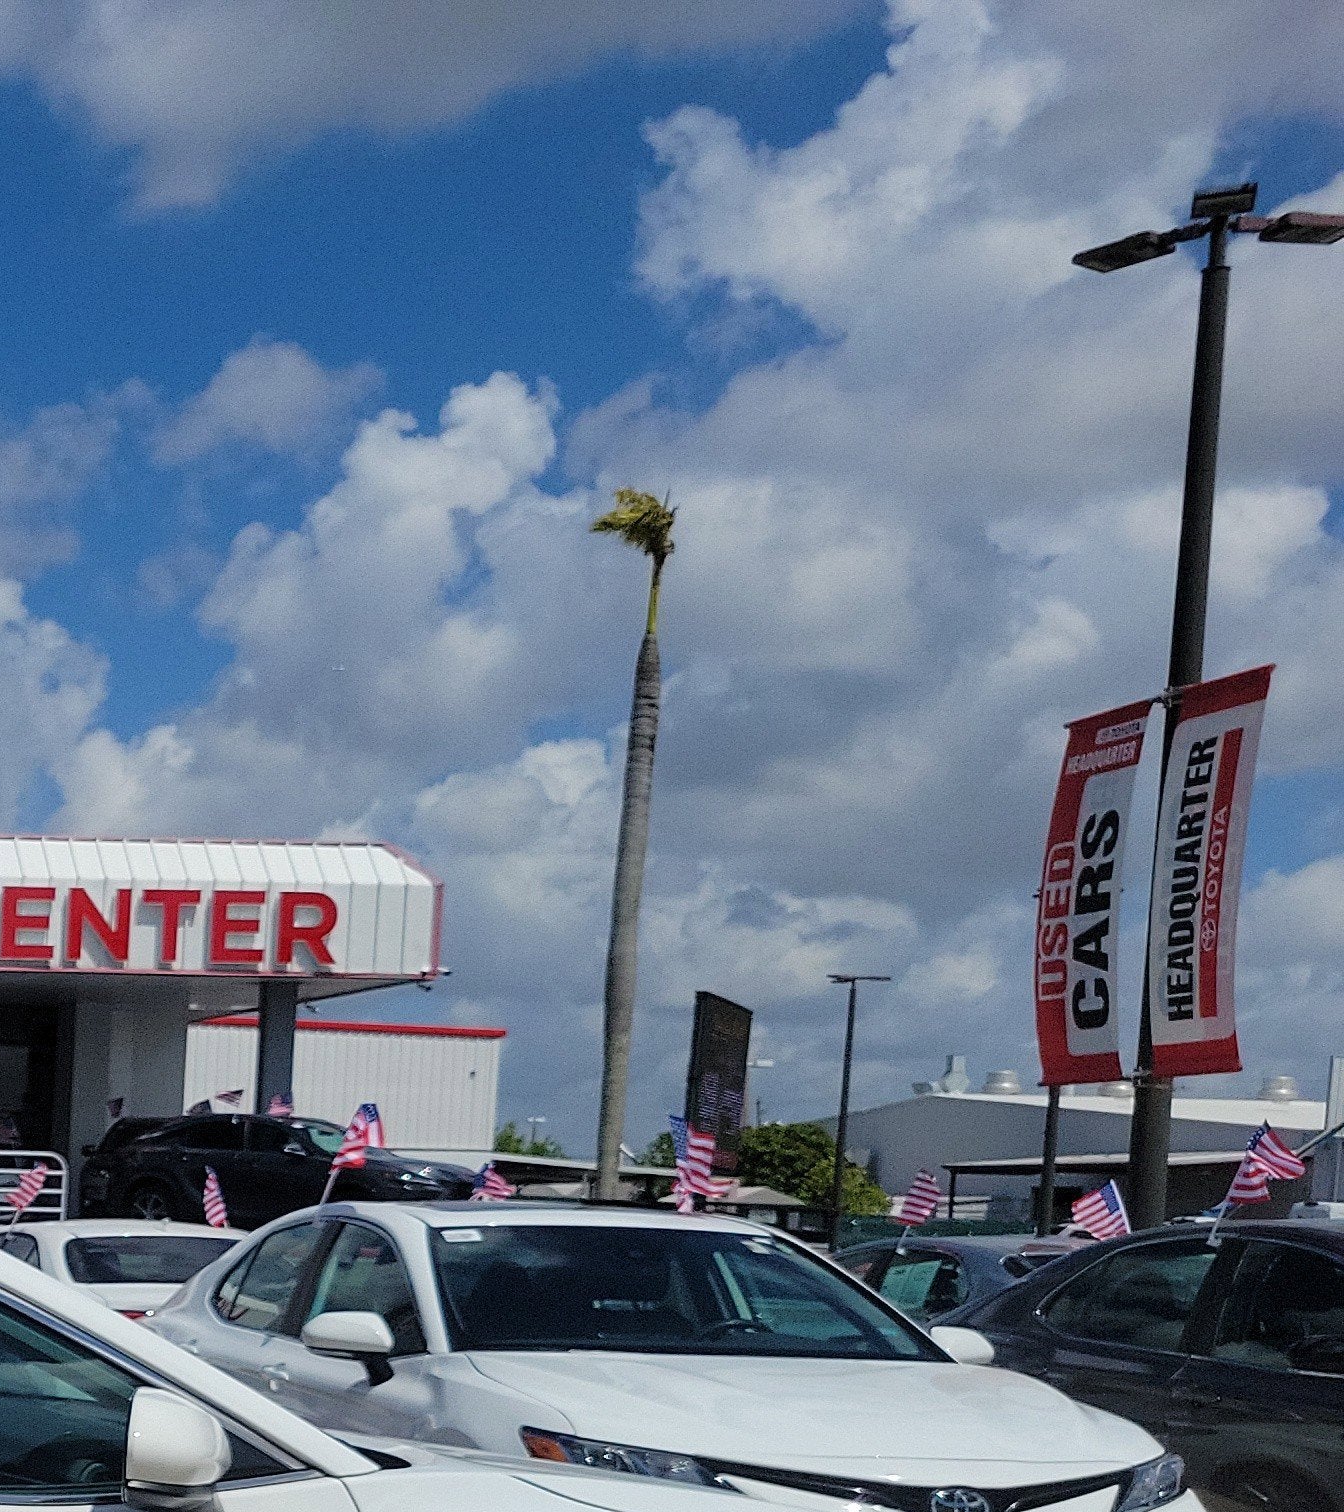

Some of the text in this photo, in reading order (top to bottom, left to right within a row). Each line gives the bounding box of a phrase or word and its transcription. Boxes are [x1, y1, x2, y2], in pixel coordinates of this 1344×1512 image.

[1039, 842, 1076, 1001] USED
[1071, 809, 1120, 1030] CARS
[1168, 736, 1218, 1022] HEADQUARTER
[1204, 806, 1228, 916] TOYOTA
